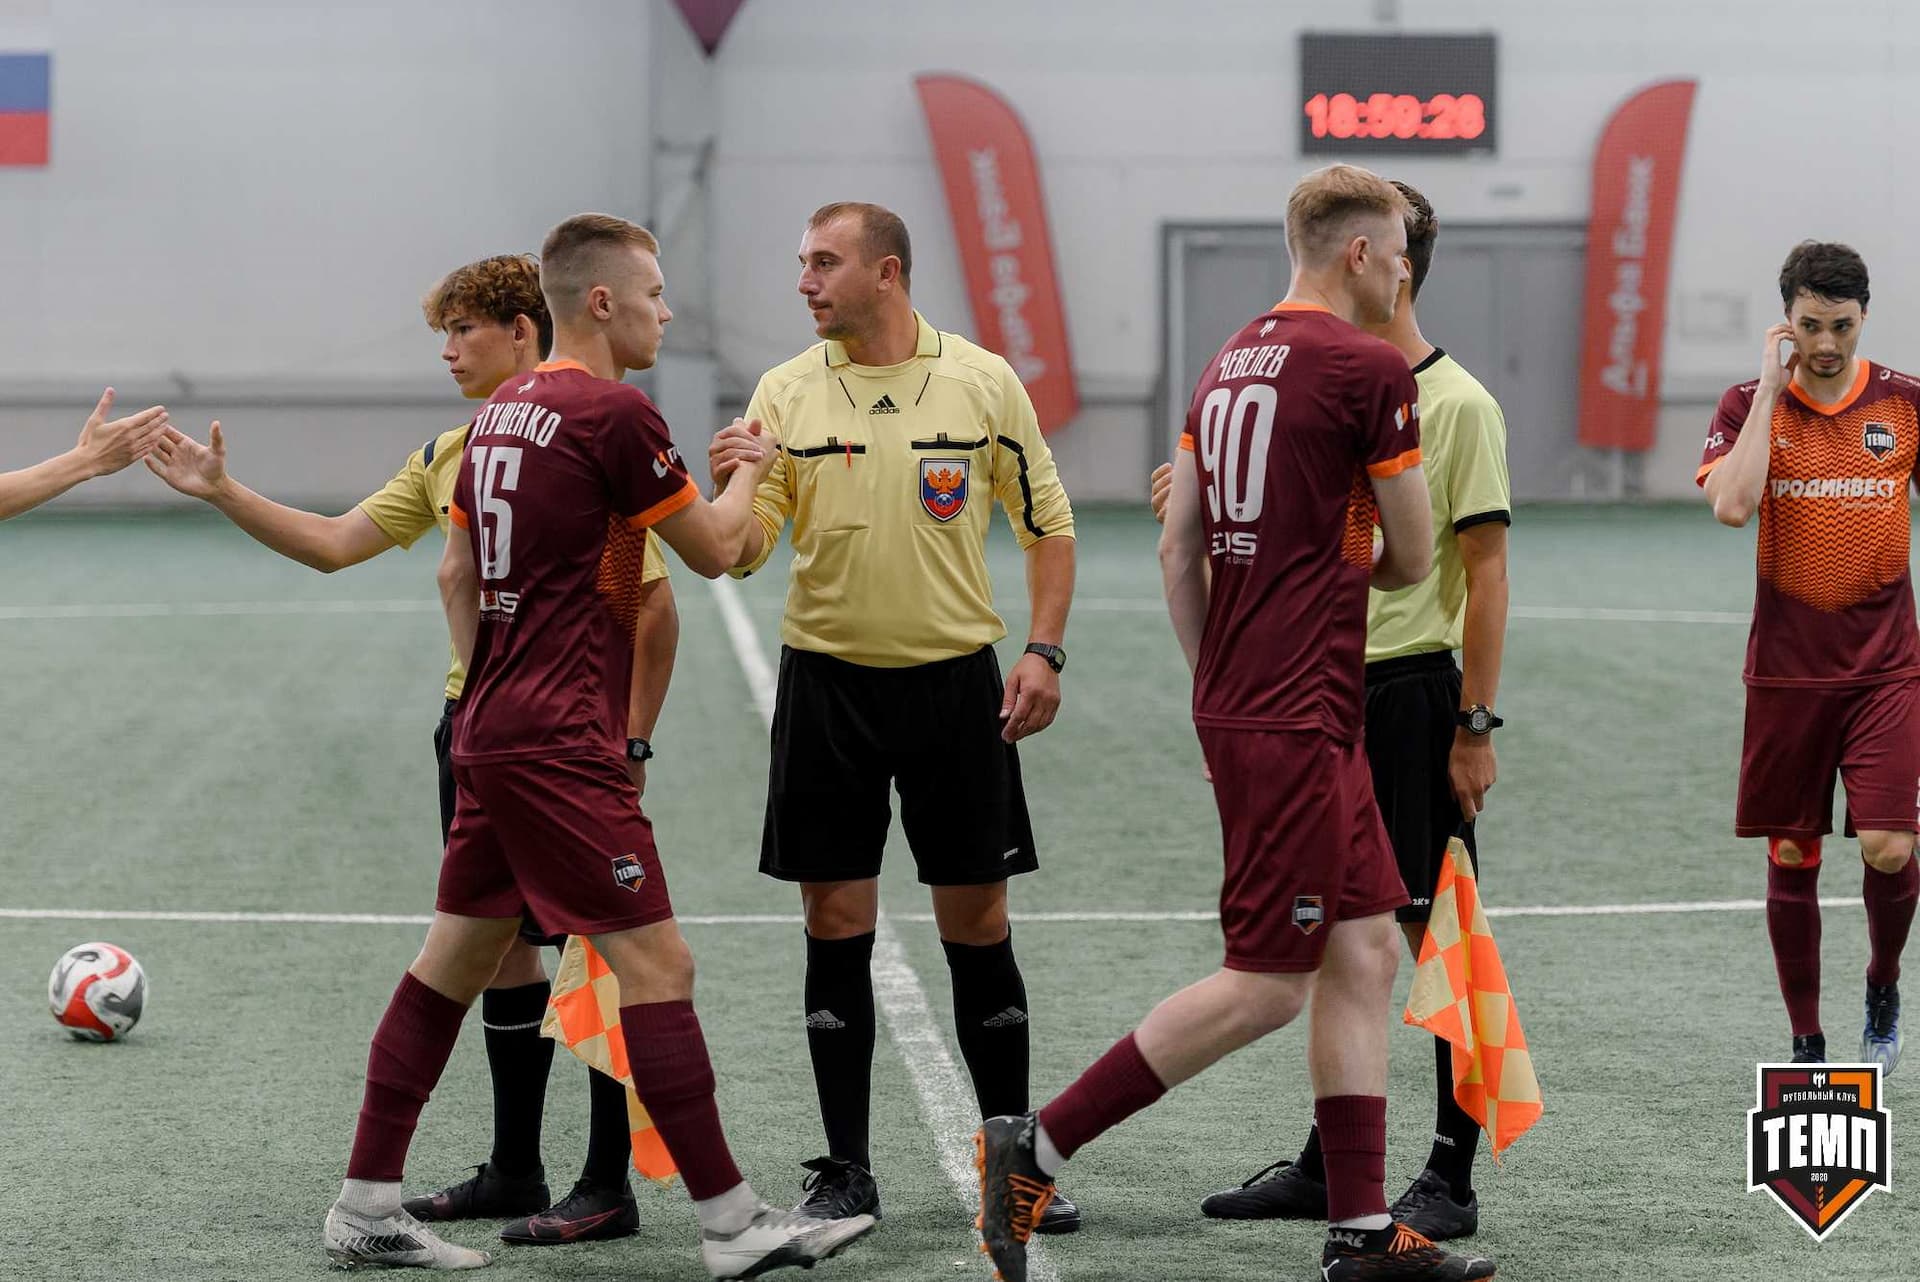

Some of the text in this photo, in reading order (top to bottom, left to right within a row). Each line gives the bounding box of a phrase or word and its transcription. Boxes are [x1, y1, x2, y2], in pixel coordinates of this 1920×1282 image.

[1218, 345, 1291, 382] ЧЕВЕЛЕВ
[869, 407, 900, 415] adidas
[1201, 384, 1278, 523] 90
[1866, 432, 1893, 448] ТЕМП
[471, 446, 523, 579] 15
